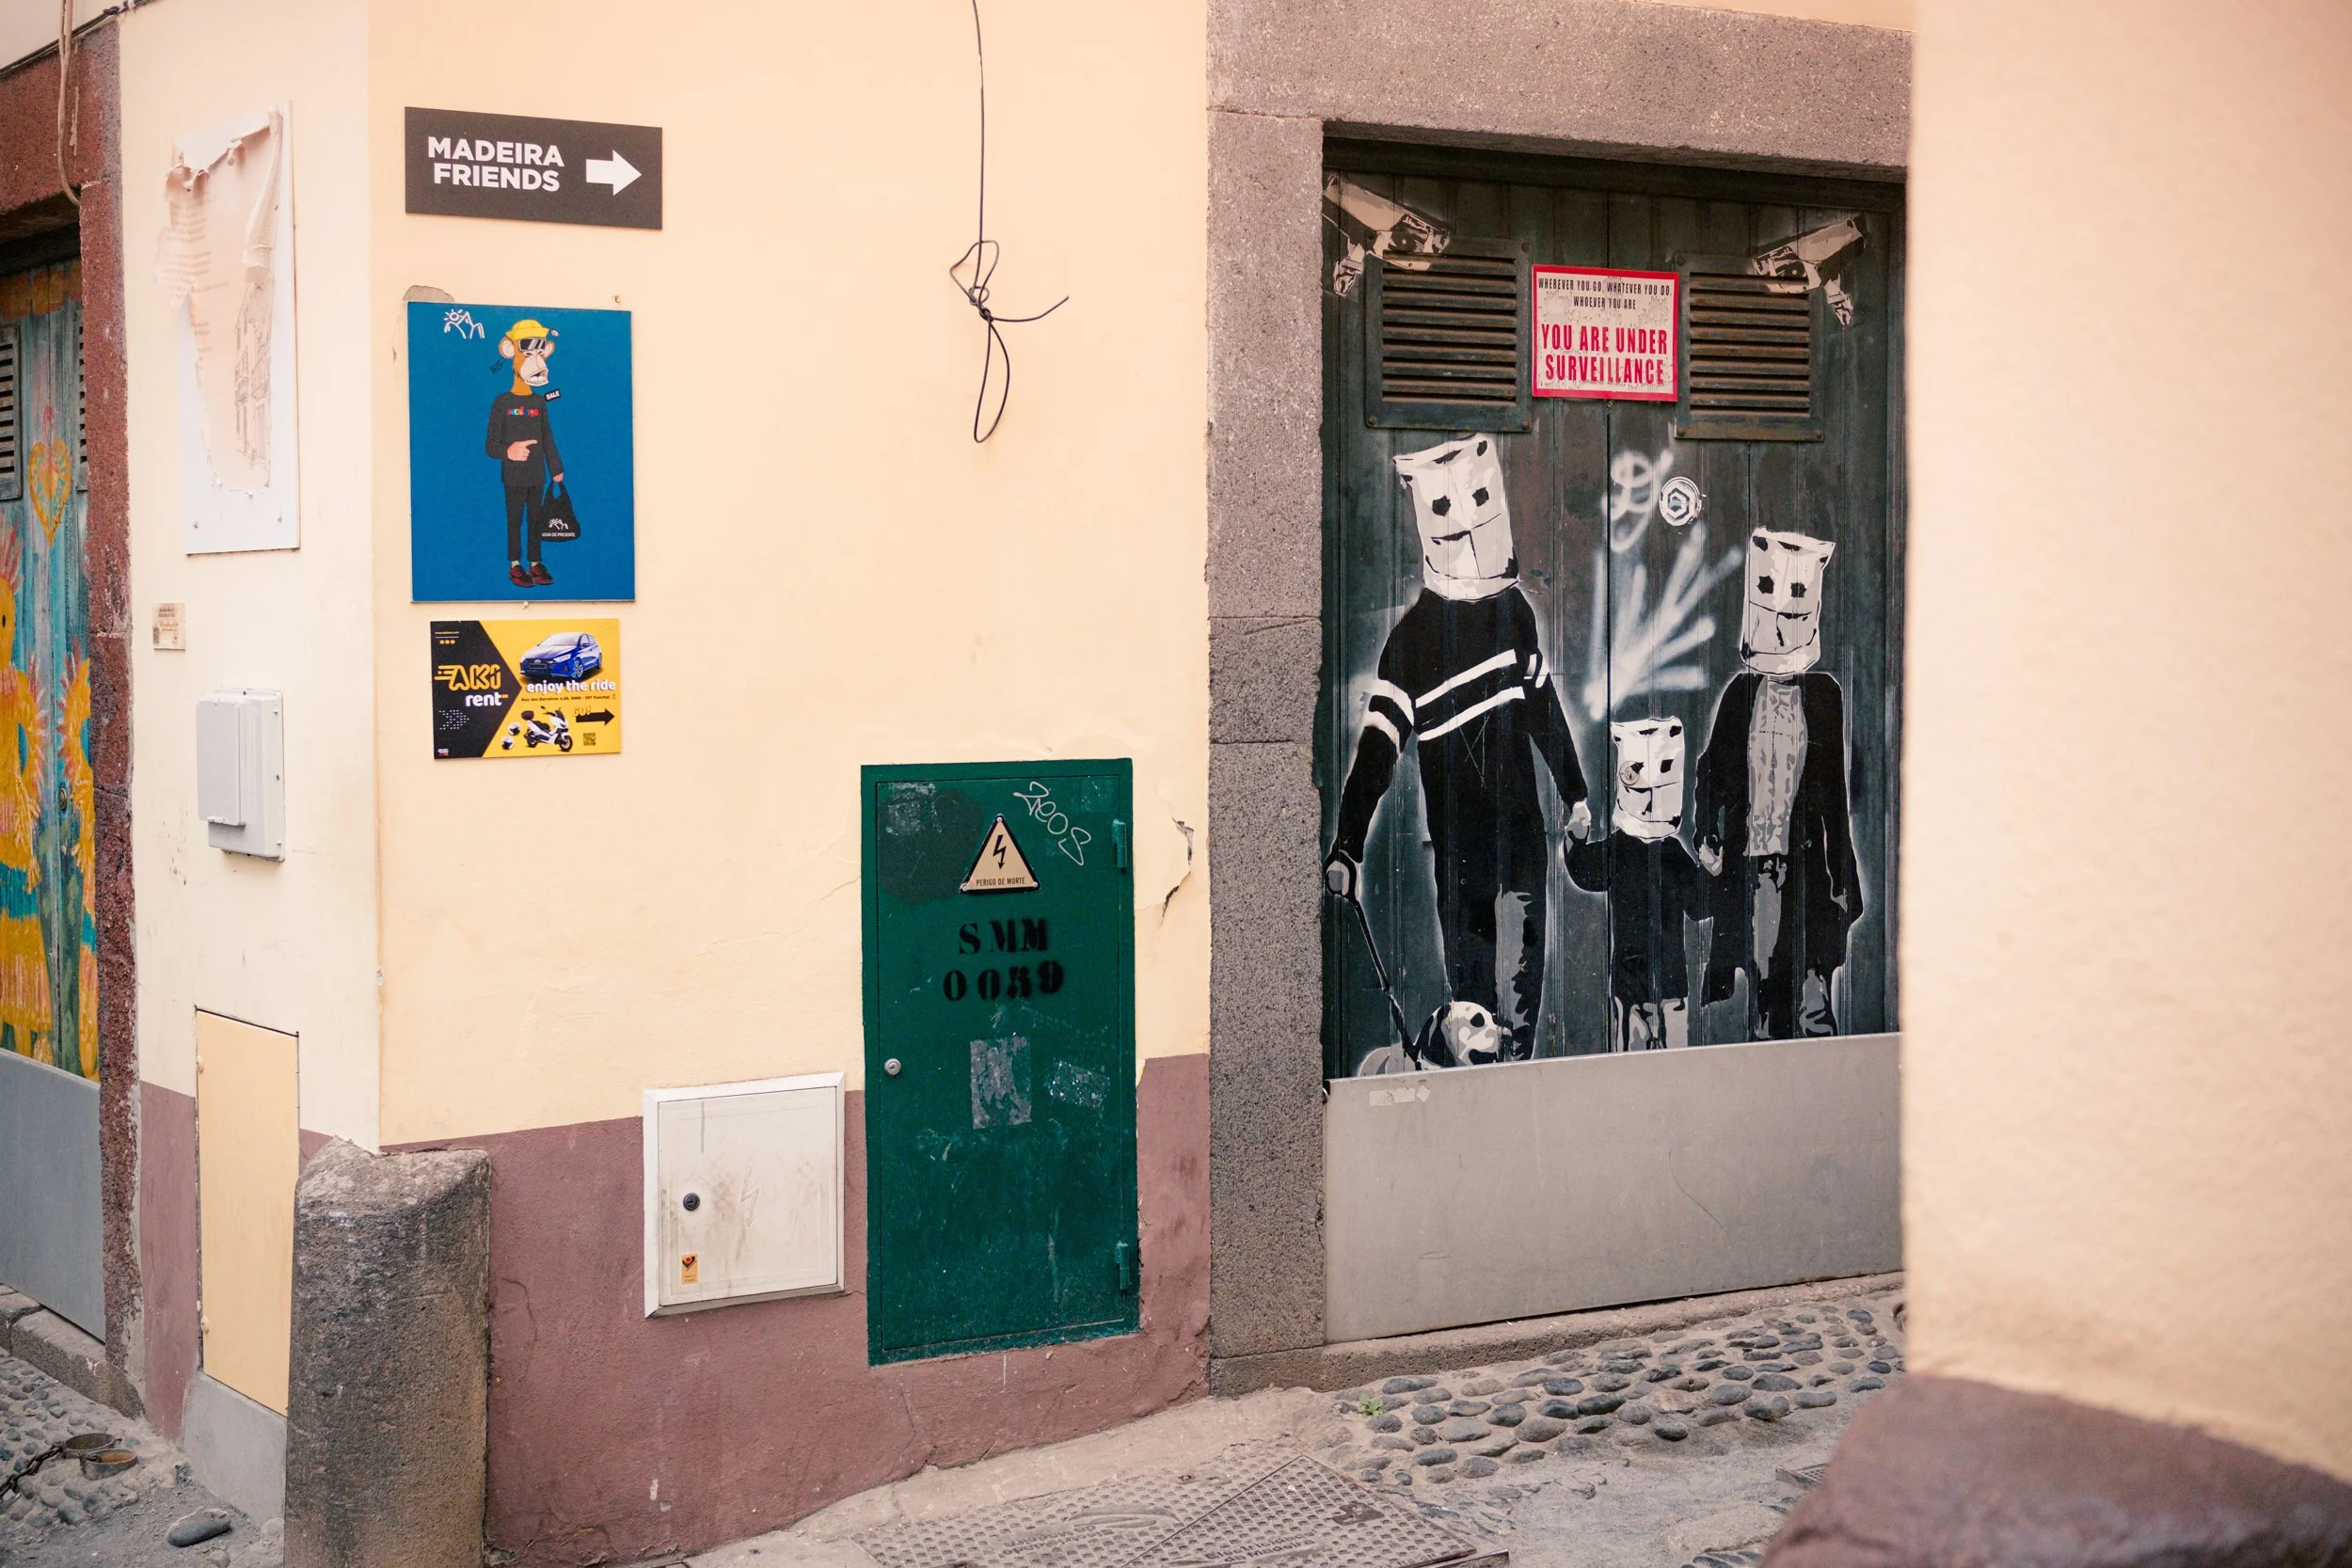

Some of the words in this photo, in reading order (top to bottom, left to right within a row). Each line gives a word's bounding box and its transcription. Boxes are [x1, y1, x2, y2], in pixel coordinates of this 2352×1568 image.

[428, 136, 564, 167] MADEIRA
[434, 163, 561, 192] FRIENDS
[1538, 277, 1574, 291] WHEREVER
[1577, 280, 1590, 292] YOU
[1607, 282, 1642, 295] WHATEVER
[1645, 284, 1658, 295] YOU
[1573, 296, 1606, 309] WHOEVER
[1609, 298, 1621, 309] YOU
[1624, 299, 1636, 309] ARE
[1541, 324, 1572, 351] YOU
[1580, 325, 1609, 353] ARE
[1616, 327, 1667, 355] UNDER
[1545, 354, 1664, 385] SURVEILLANCE
[546, 390, 560, 401] SALE
[527, 680, 564, 695] enjoy
[566, 679, 587, 691] the
[591, 678, 616, 690] ride
[466, 692, 502, 706] rent
[976, 879, 996, 887] PERIGO
[1007, 877, 1025, 885] MORTE
[959, 918, 1048, 955] SMM
[942, 960, 1064, 1002] 0059
